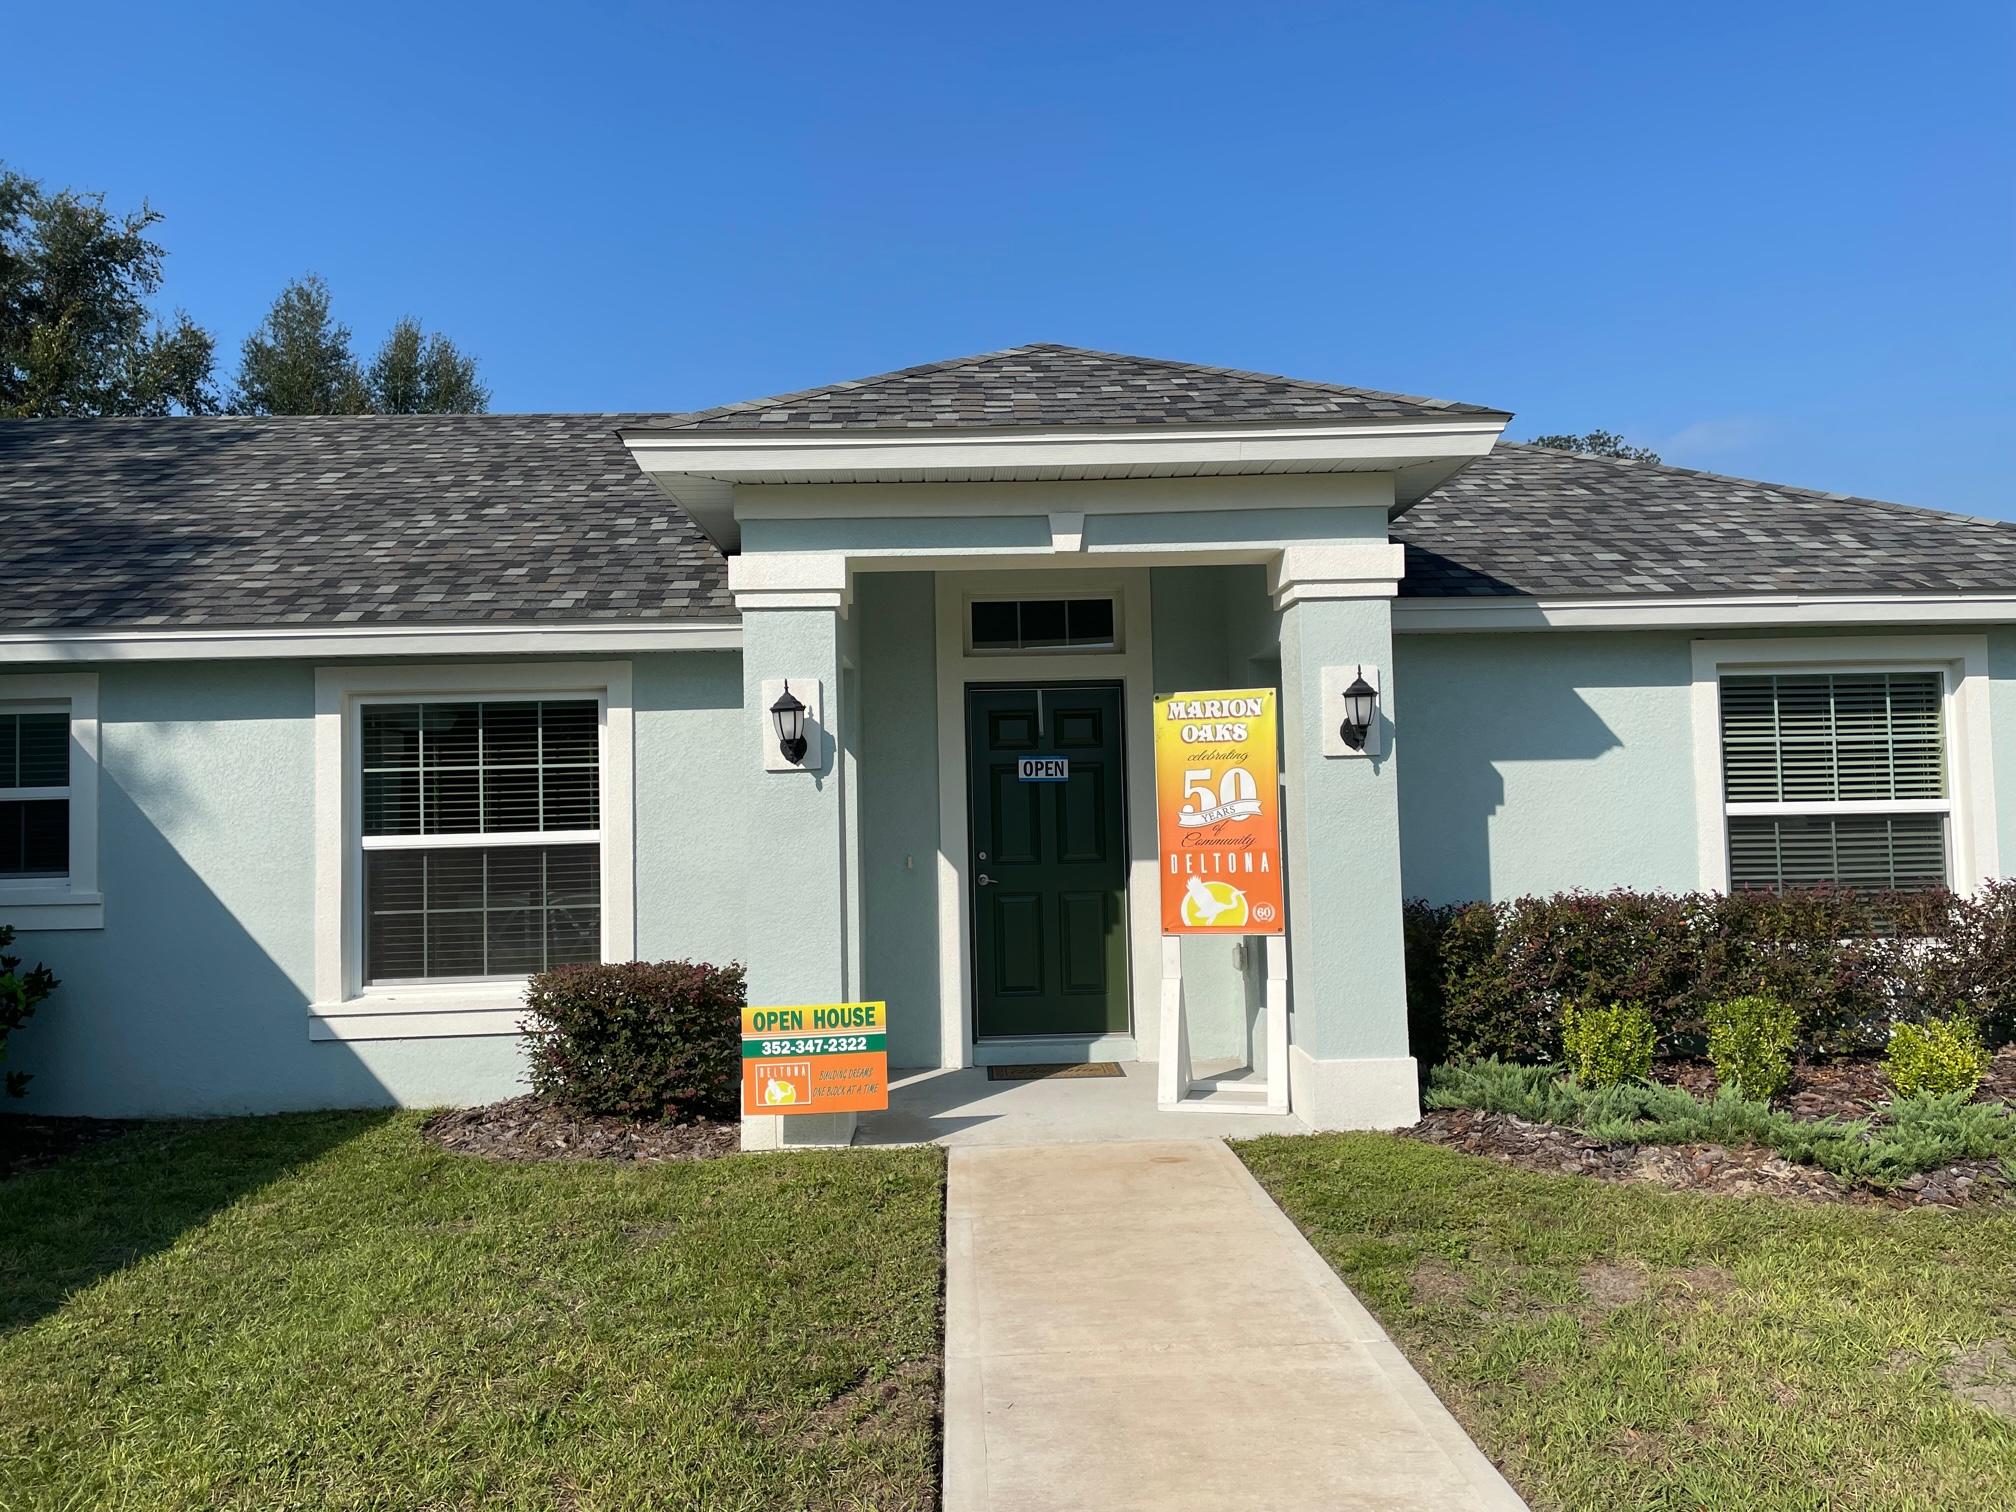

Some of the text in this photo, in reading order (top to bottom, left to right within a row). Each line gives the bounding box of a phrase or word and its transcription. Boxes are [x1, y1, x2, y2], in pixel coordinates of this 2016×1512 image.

[1168, 698, 1262, 720] MARION
[1181, 724, 1248, 744] OAKS
[1187, 749, 1249, 763] celebrating
[1023, 761, 1064, 776] OPEN
[1182, 767, 1257, 821] 50
[1201, 805, 1236, 823] YEARS
[1211, 820, 1229, 837] of
[1181, 831, 1255, 849] Community
[1170, 852, 1269, 874] DELTONA
[1257, 907, 1271, 918] 60
[753, 1007, 876, 1032] OPEN HOUSE
[761, 1037, 867, 1055] 352-347-2322
